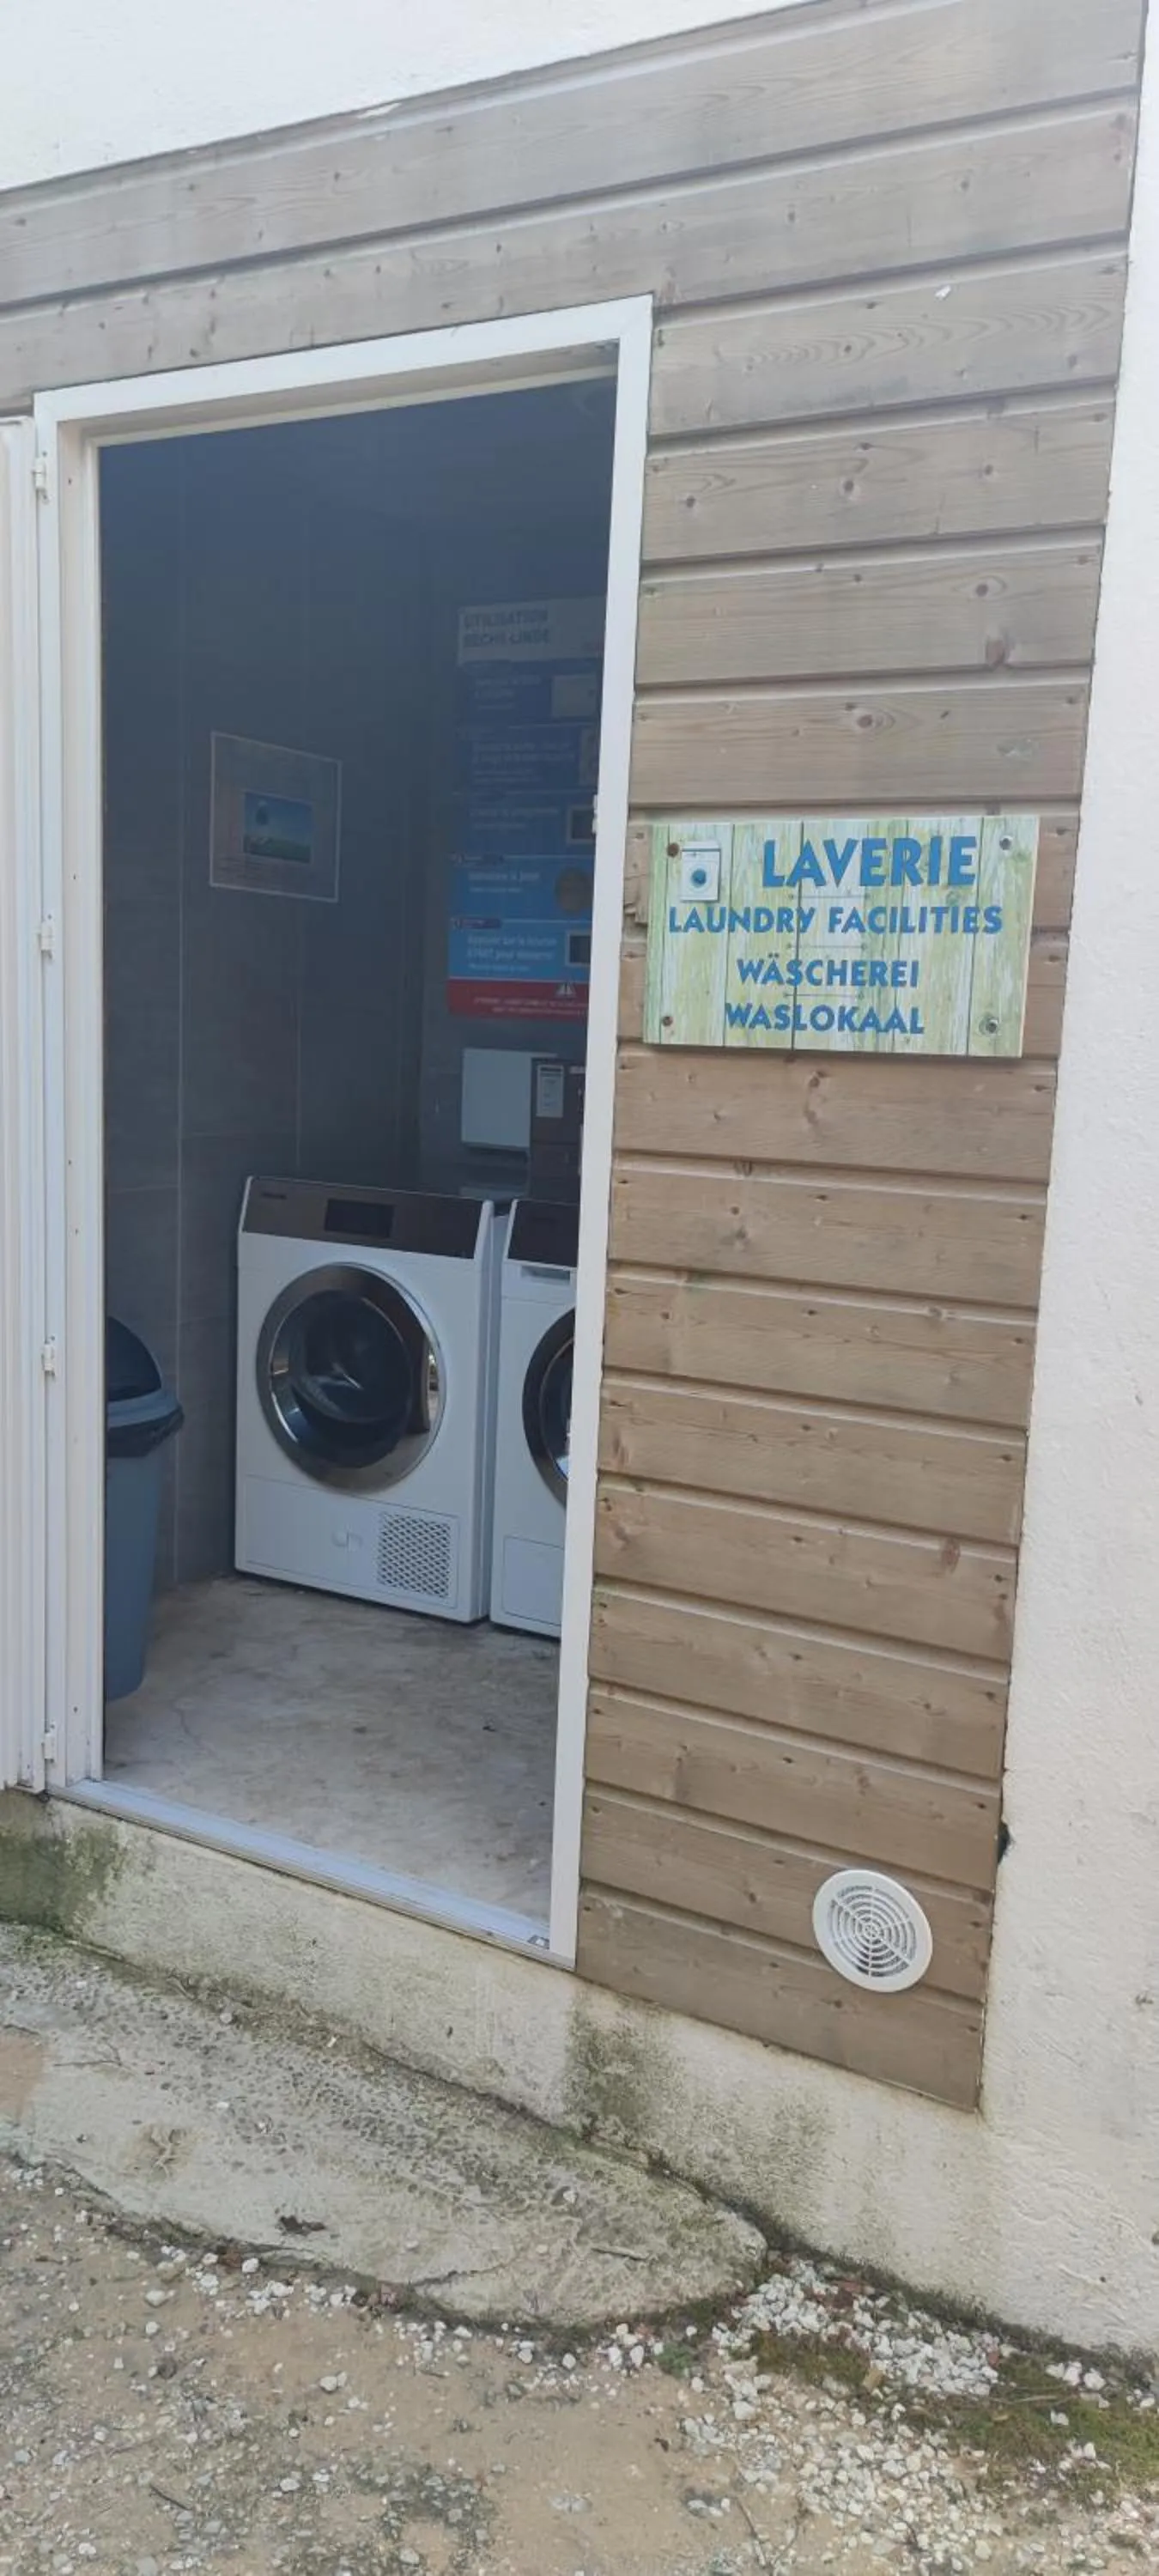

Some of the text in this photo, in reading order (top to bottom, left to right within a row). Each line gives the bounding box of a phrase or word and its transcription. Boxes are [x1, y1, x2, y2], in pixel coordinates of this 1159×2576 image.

[762, 835, 978, 888] LAVERIE
[669, 906, 1003, 935] LAUNDRY FACILITIES
[738, 953, 919, 987] WÄSCHEREI
[725, 1002, 925, 1035] WASLOKAAL
